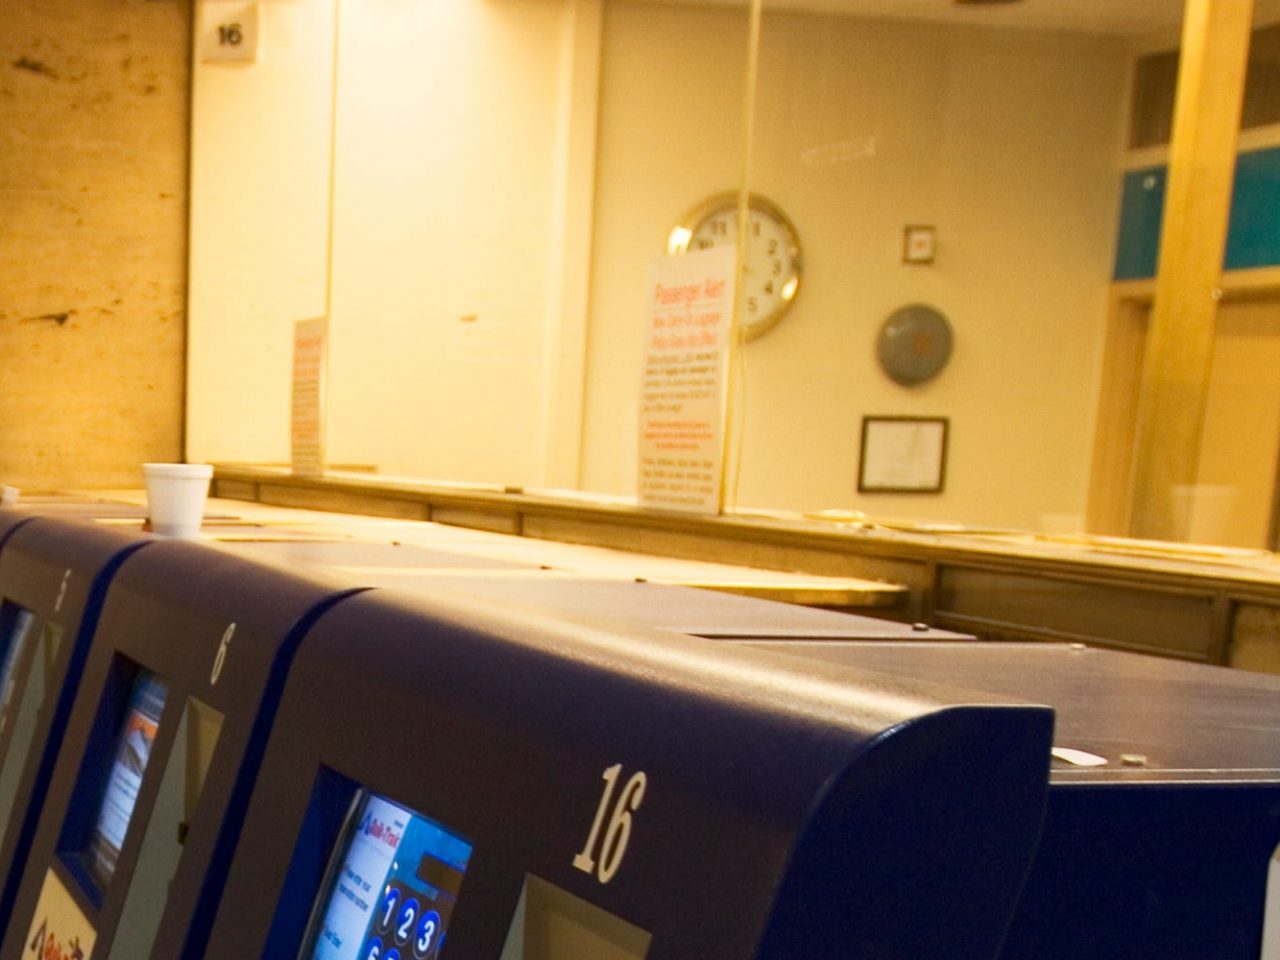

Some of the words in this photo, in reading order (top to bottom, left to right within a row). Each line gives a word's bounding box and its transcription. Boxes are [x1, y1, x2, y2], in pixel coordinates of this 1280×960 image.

[218, 23, 243, 46] 16
[767, 239, 778, 256] 2
[572, 763, 647, 884] 16
[383, 897, 397, 926] 1
[397, 907, 415, 939] 2
[418, 919, 435, 952] 3
